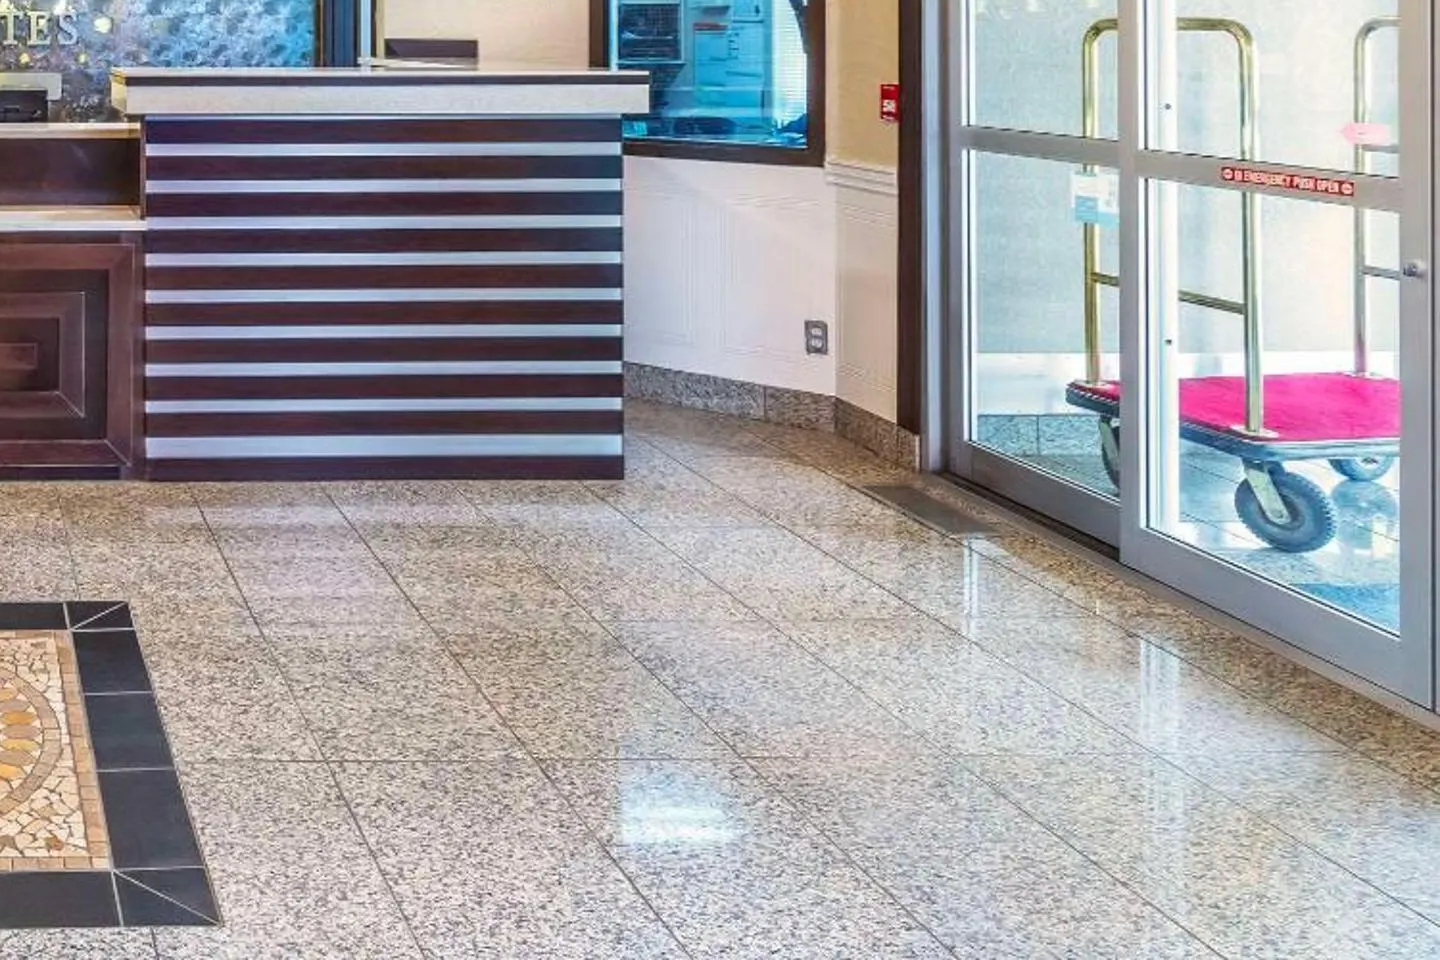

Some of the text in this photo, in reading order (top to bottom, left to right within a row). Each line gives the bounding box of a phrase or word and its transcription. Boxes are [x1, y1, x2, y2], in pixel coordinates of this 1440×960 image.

[1243, 171, 1291, 188] EMERGENCY
[1293, 176, 1315, 190] PUSH
[1317, 180, 1339, 194] OPEN
